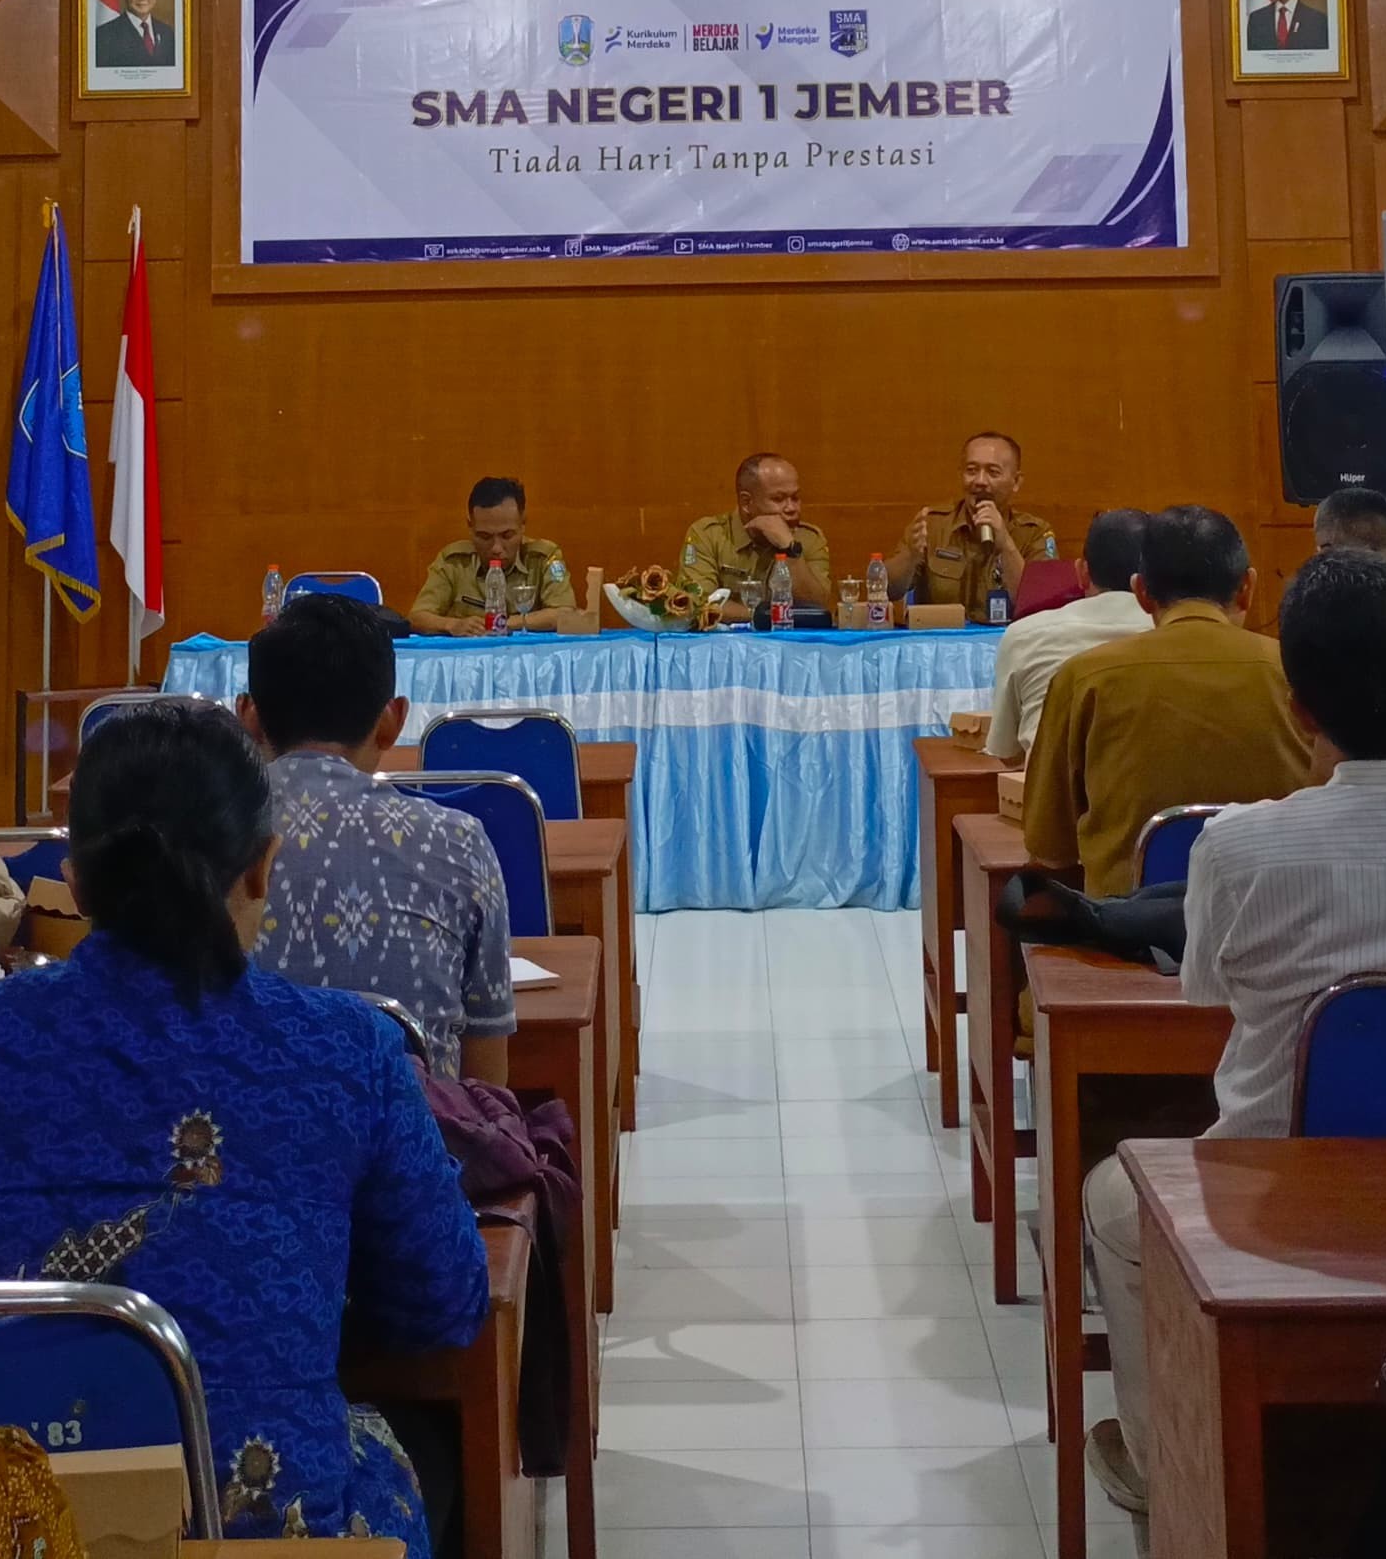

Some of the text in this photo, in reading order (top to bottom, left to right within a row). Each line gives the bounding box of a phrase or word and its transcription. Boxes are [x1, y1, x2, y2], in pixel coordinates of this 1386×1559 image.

[836, 12, 862, 24] SMA
[626, 28, 678, 40] Kurikulum
[692, 23, 740, 38] MERDEKA
[778, 26, 818, 36] Merdeka
[626, 40, 671, 50] Merdeka
[692, 37, 740, 52] BELAJAR
[778, 35, 821, 47] Mengajar
[411, 78, 1013, 130] SMA NEGERI 1 JEMBER
[488, 140, 937, 177] Tiada Hari Tanpa Prestasi
